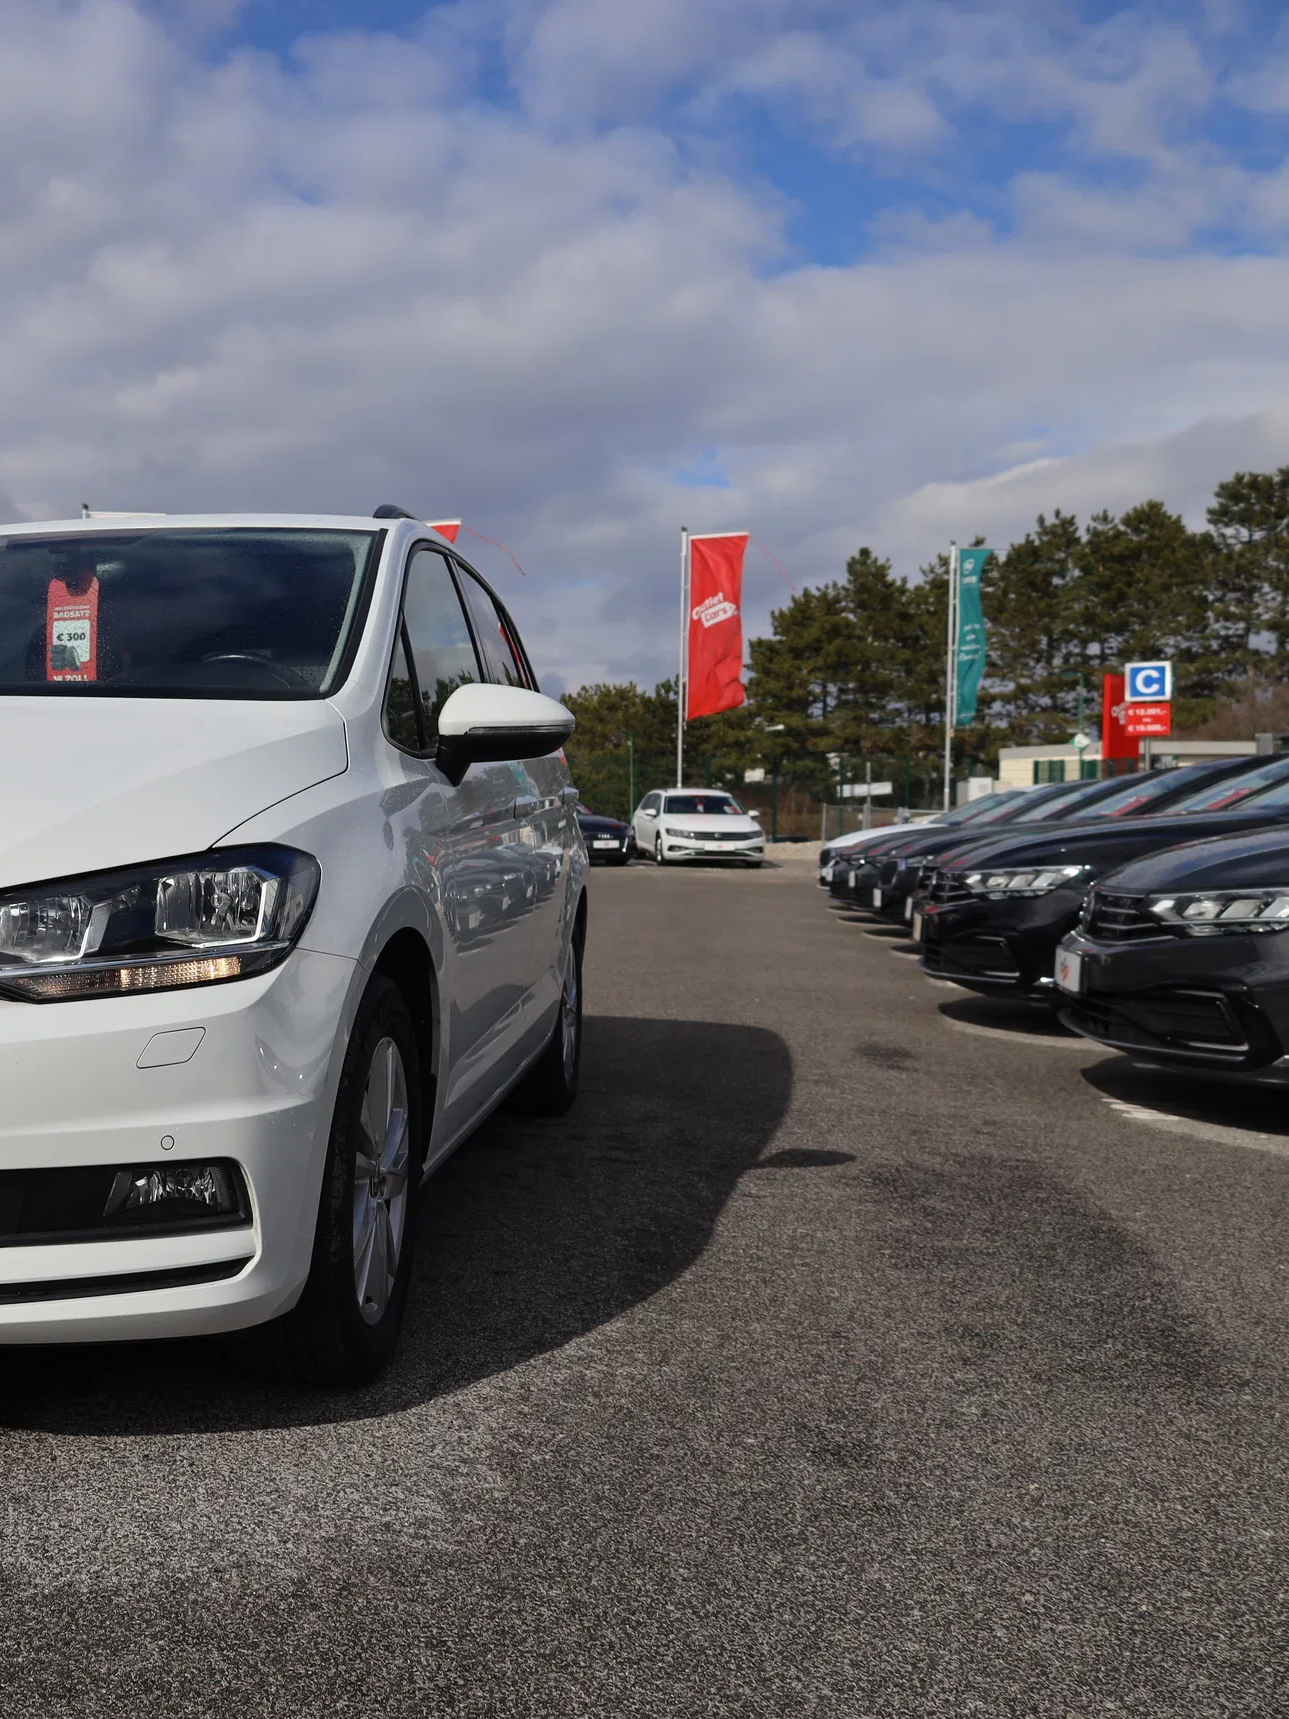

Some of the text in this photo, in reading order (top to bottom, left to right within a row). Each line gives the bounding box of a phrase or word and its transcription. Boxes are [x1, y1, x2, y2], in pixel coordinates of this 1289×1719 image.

[56, 632, 86, 642] € 300
[1135, 669, 1160, 694] C
